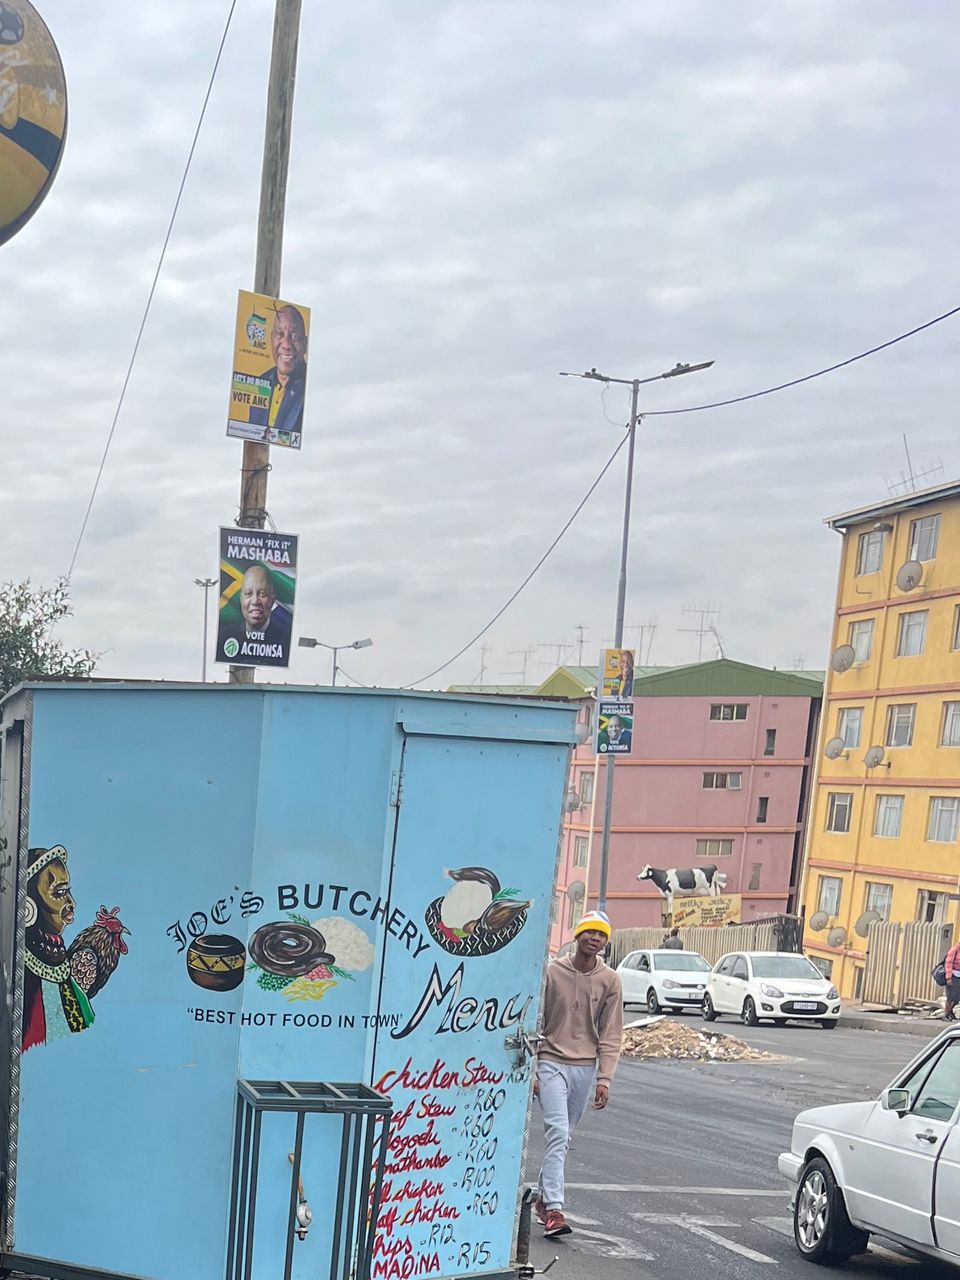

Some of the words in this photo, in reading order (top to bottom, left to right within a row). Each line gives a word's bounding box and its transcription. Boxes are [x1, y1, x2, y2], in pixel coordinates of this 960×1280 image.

[233, 391, 251, 404] VOTE
[252, 394, 268, 408] ANC
[227, 535, 263, 547] HERMAN
[227, 545, 291, 564] MASHABA
[246, 631, 265, 641] VOTE
[240, 641, 283, 659] ACTIONSA
[277, 883, 431, 960] BUTCHERY
[390, 961, 533, 1040] Menu
[241, 1012, 277, 1027] HOT
[282, 1013, 332, 1029] FOOD
[338, 1015, 355, 1029] IN
[461, 1056, 504, 1088] Stew
[416, 1093, 457, 1119] Stew
[372, 1233, 414, 1265] hips
[457, 1241, 492, 1269] R15
